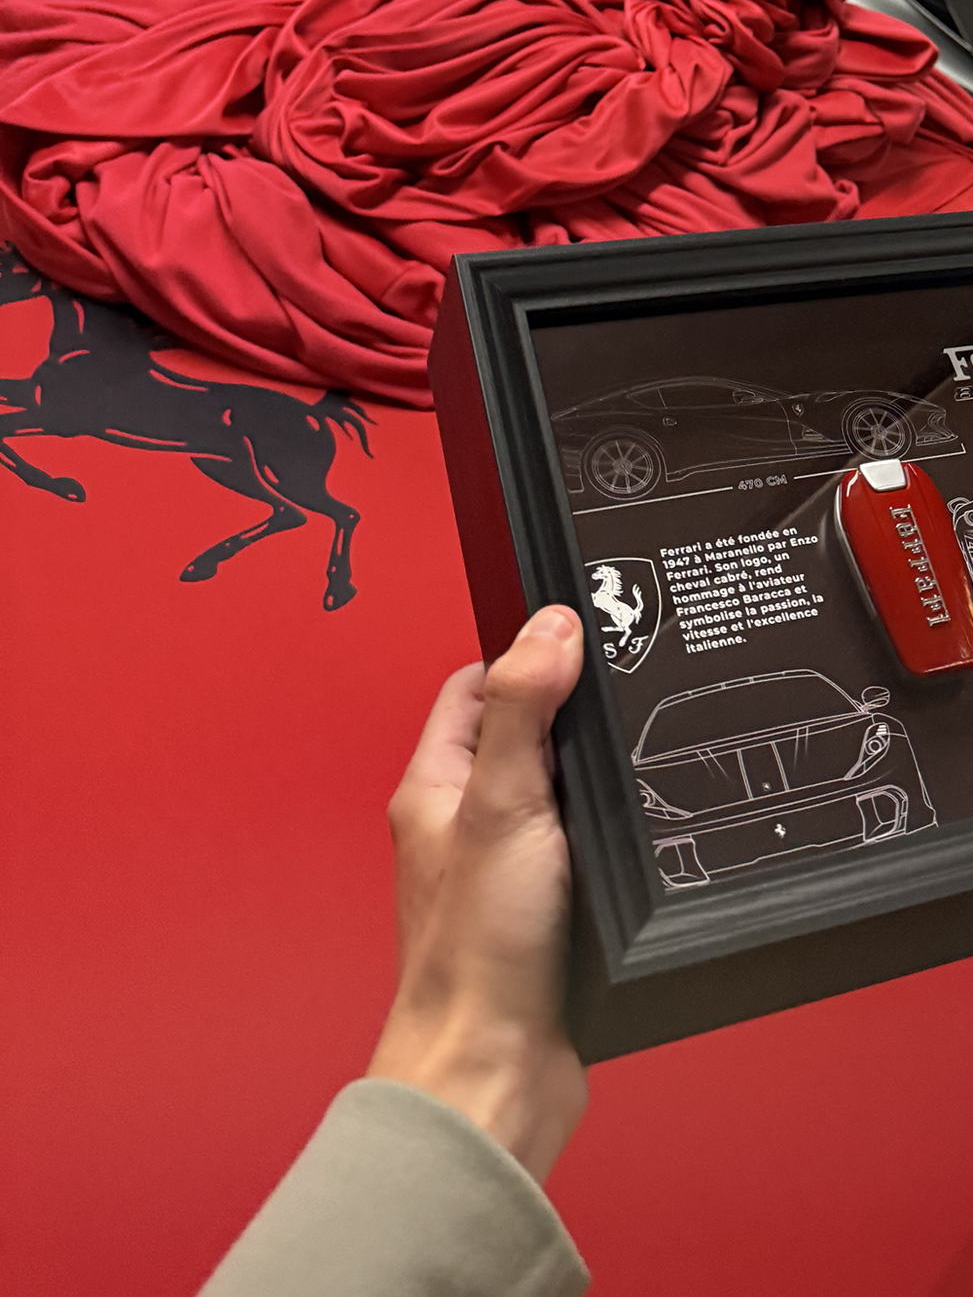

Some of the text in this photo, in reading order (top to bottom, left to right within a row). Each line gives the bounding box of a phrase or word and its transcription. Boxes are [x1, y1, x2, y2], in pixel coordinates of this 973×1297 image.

[737, 474, 788, 491] 470 CM
[660, 542, 701, 557] Ferrari
[715, 536, 735, 547] été
[737, 530, 779, 543] fondée
[782, 527, 797, 536] en
[662, 536, 818, 569] 1947 à Maranello par Enzo
[666, 552, 789, 581] Ferrari. Son logo, un
[669, 563, 782, 592] cheval cabré, rend
[889, 504, 951, 627] Ferrari
[672, 573, 804, 604] hommage à l'aviateur
[676, 585, 807, 617] Francesco Baracca et
[679, 594, 823, 629] symbolise la passion, la
[682, 608, 818, 640] vitesse et l'excellence
[685, 635, 746, 653] italienne.
